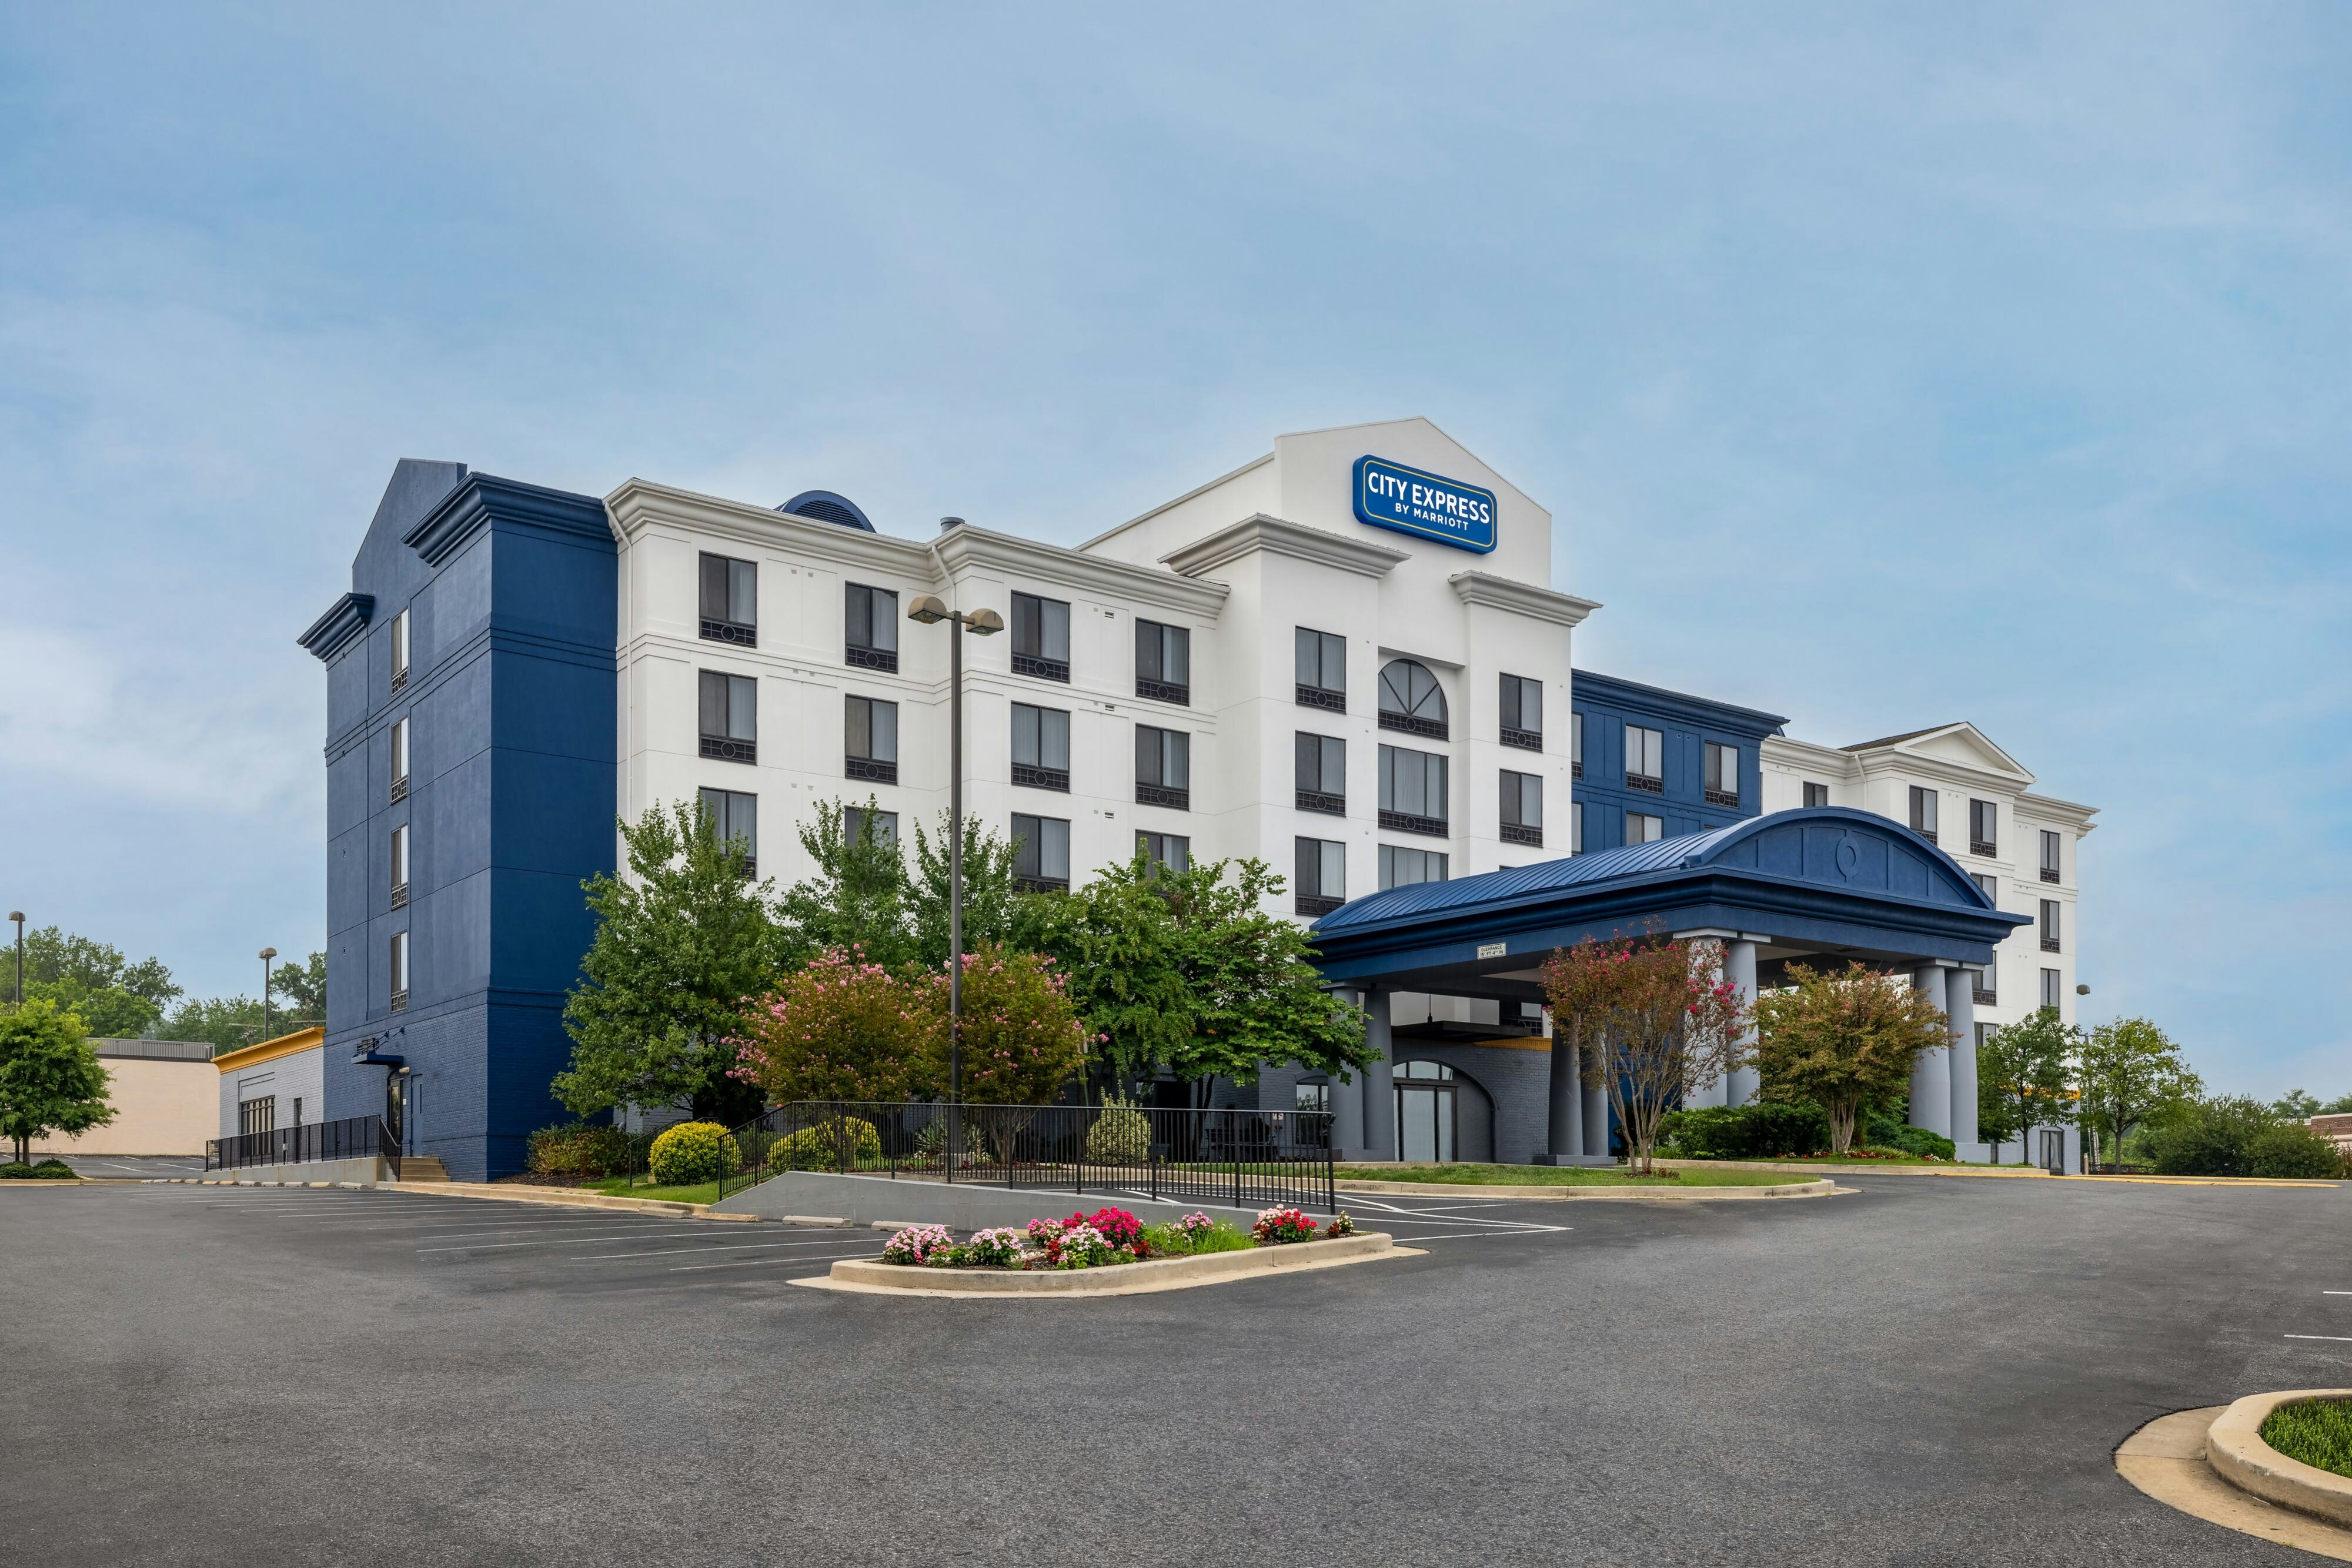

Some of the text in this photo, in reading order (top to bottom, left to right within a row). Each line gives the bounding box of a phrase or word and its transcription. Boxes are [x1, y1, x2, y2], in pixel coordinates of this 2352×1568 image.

[1368, 472, 1490, 524] CITY EXPRESS
[1395, 503, 1469, 530] BY MARRIOTT
